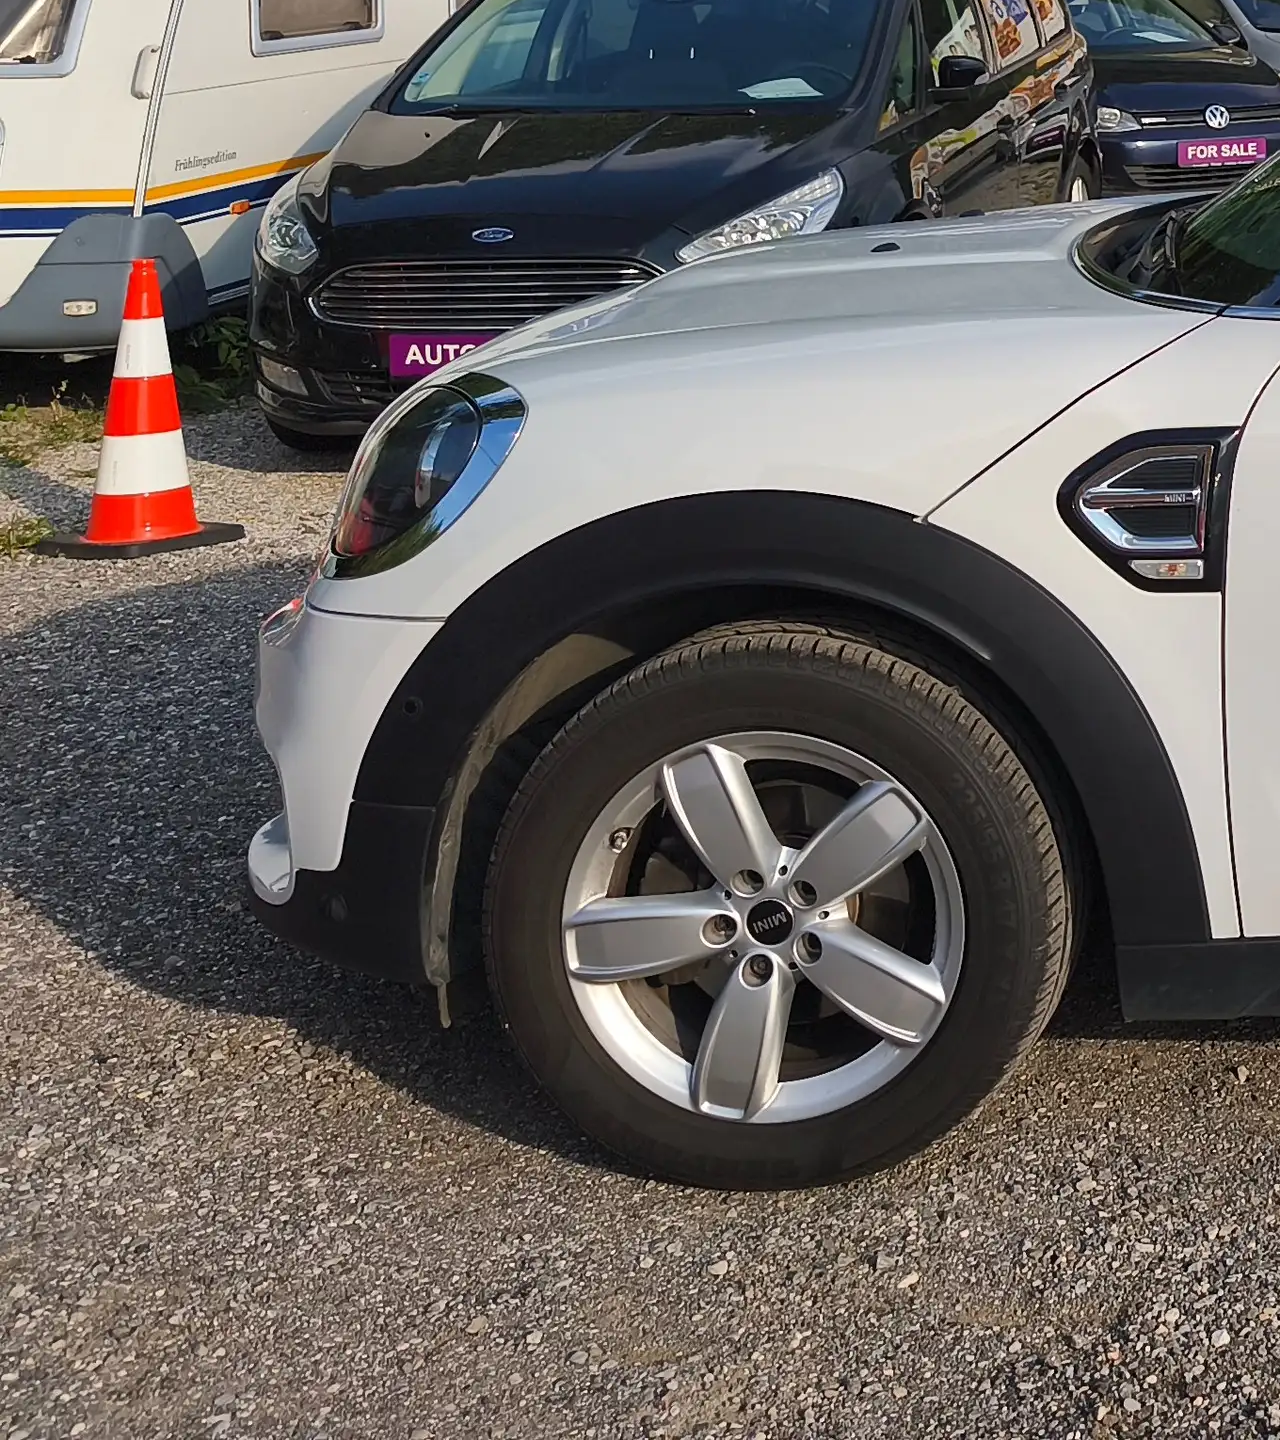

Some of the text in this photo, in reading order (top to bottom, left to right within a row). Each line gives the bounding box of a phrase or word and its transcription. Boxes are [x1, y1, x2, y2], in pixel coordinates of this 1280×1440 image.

[174, 150, 237, 172] Frühlingsedition
[1187, 143, 1258, 160] FOR SALE
[752, 911, 787, 934] MINI
